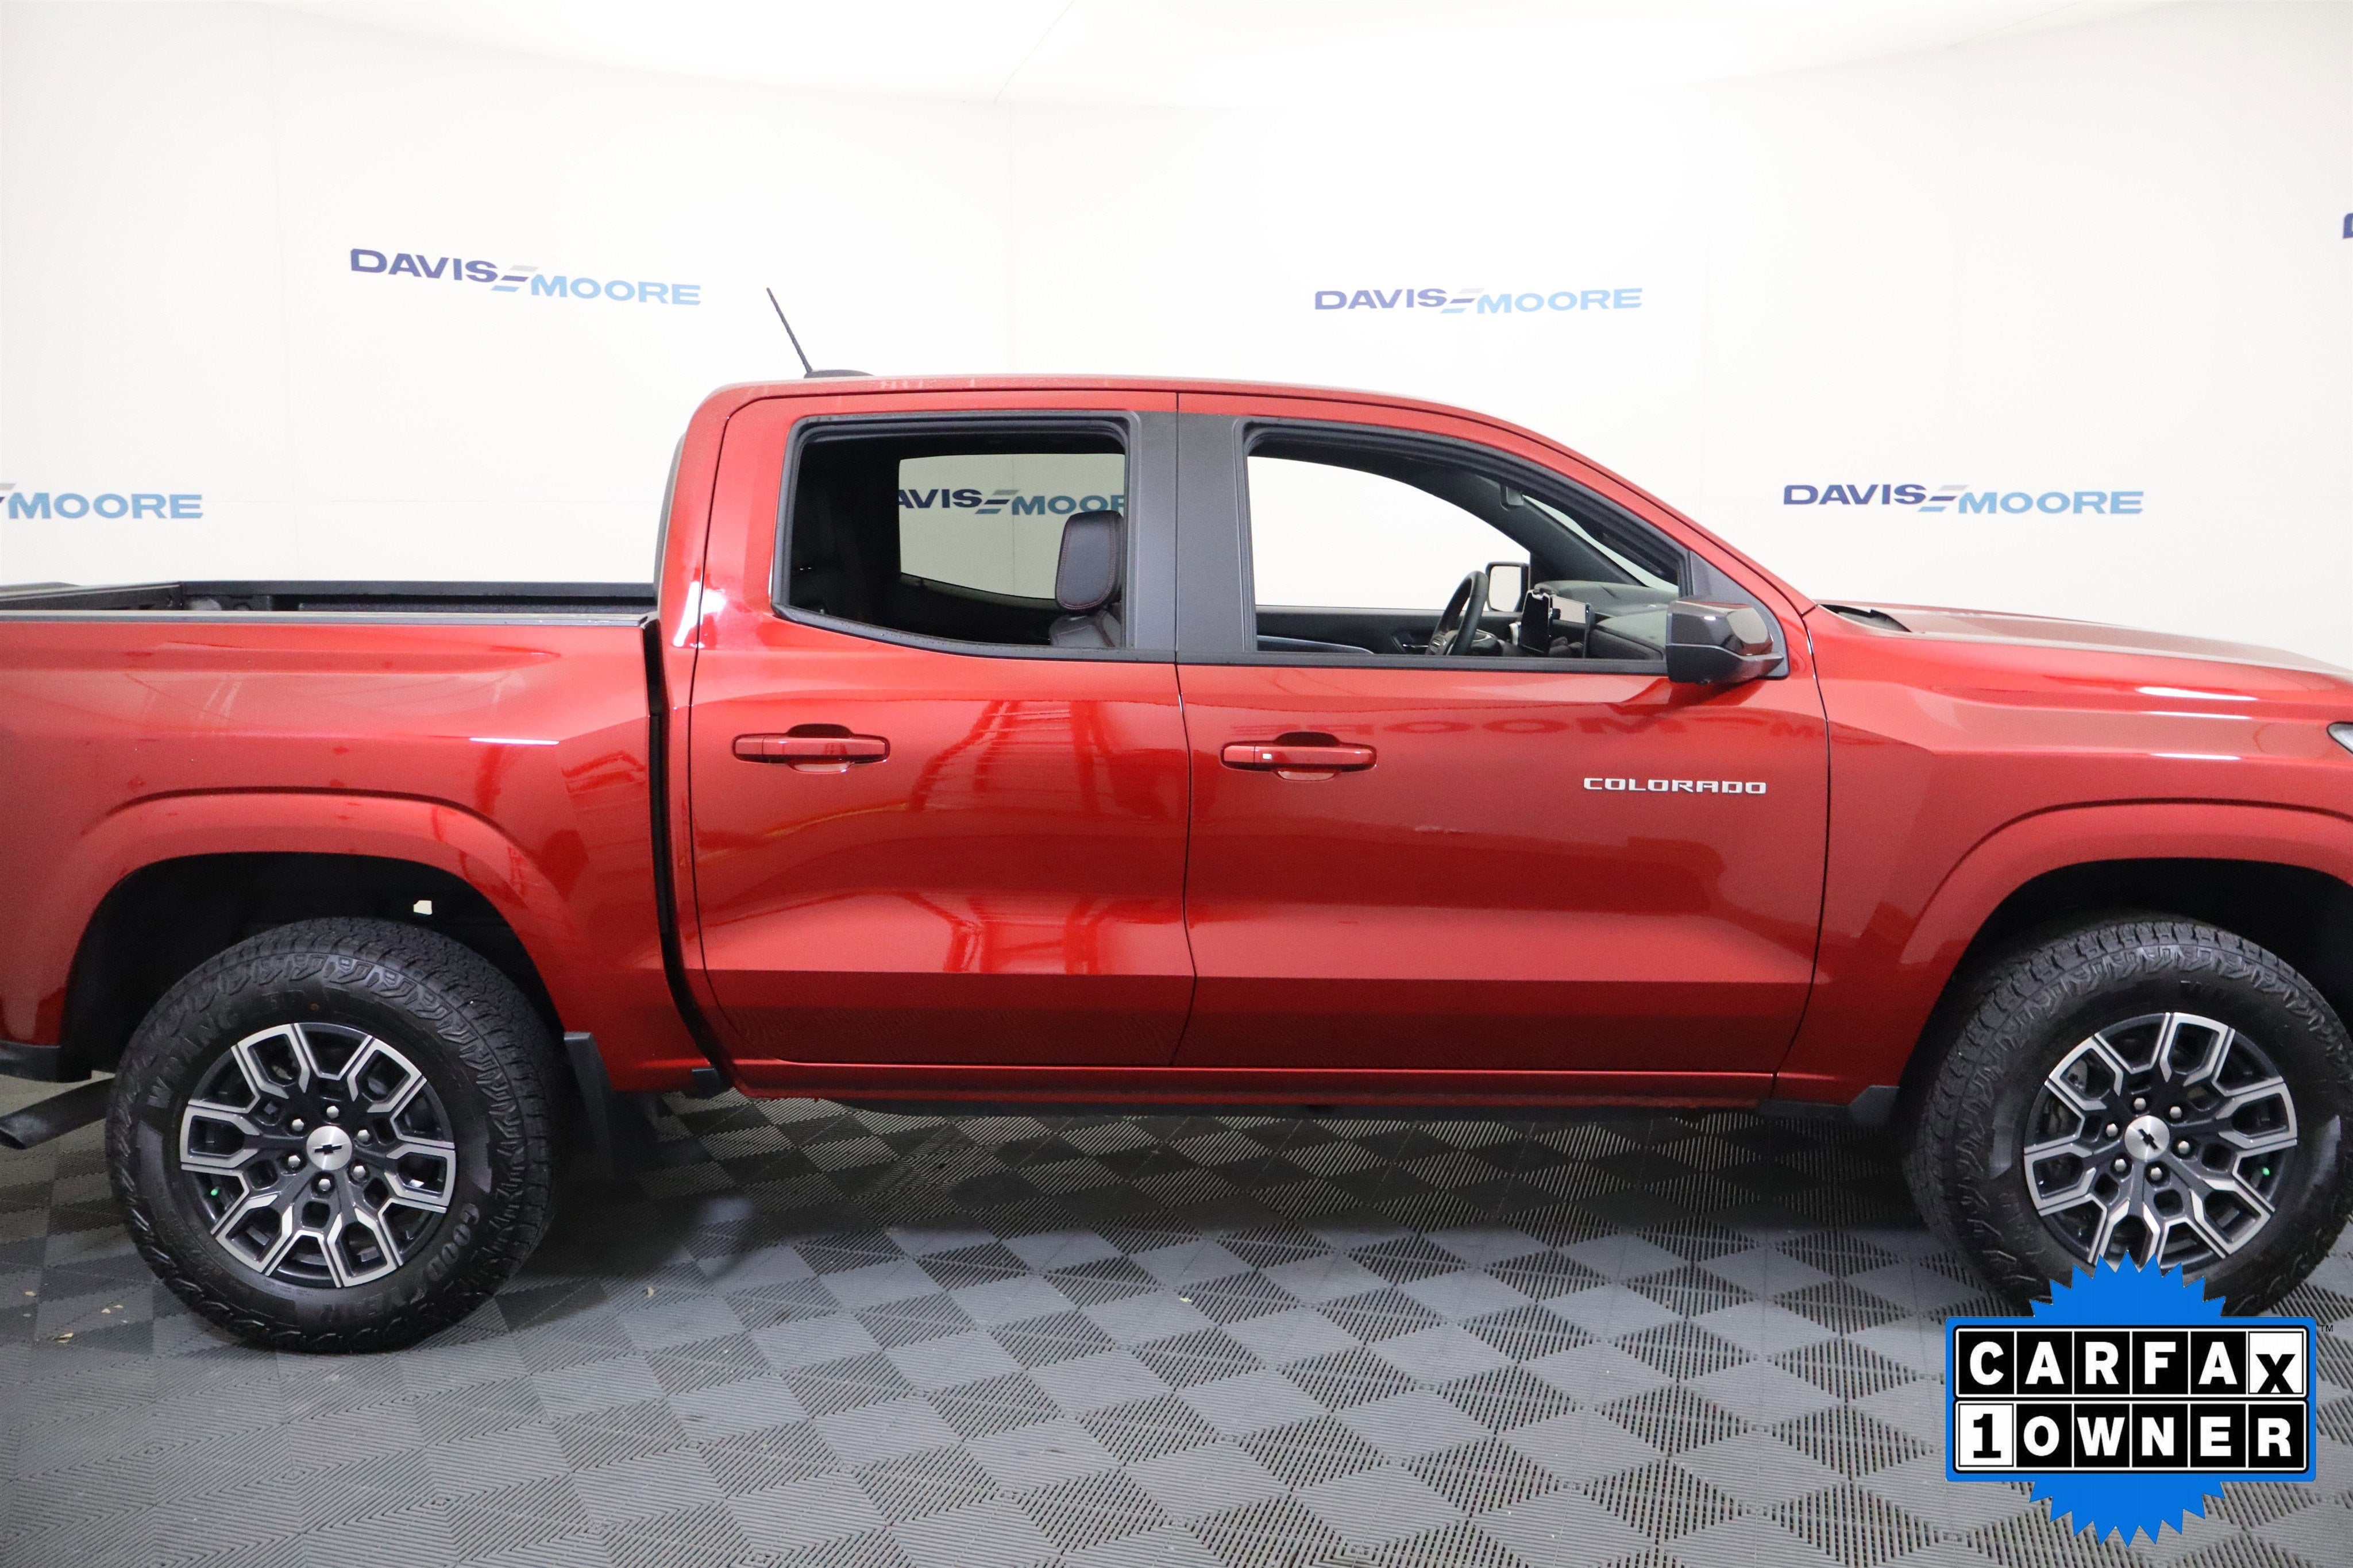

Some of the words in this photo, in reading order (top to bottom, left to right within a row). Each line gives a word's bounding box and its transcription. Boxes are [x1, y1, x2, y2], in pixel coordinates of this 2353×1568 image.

[350, 248, 498, 283] DAVIS
[531, 275, 701, 305] MOORE
[1315, 288, 1447, 310] DAVIS
[1478, 288, 1642, 314] MOORE
[7, 492, 203, 519] MOORE
[1784, 484, 1925, 505] DAVIS
[1958, 491, 2143, 514] MOORE
[1583, 778, 1767, 795] COLORADO
